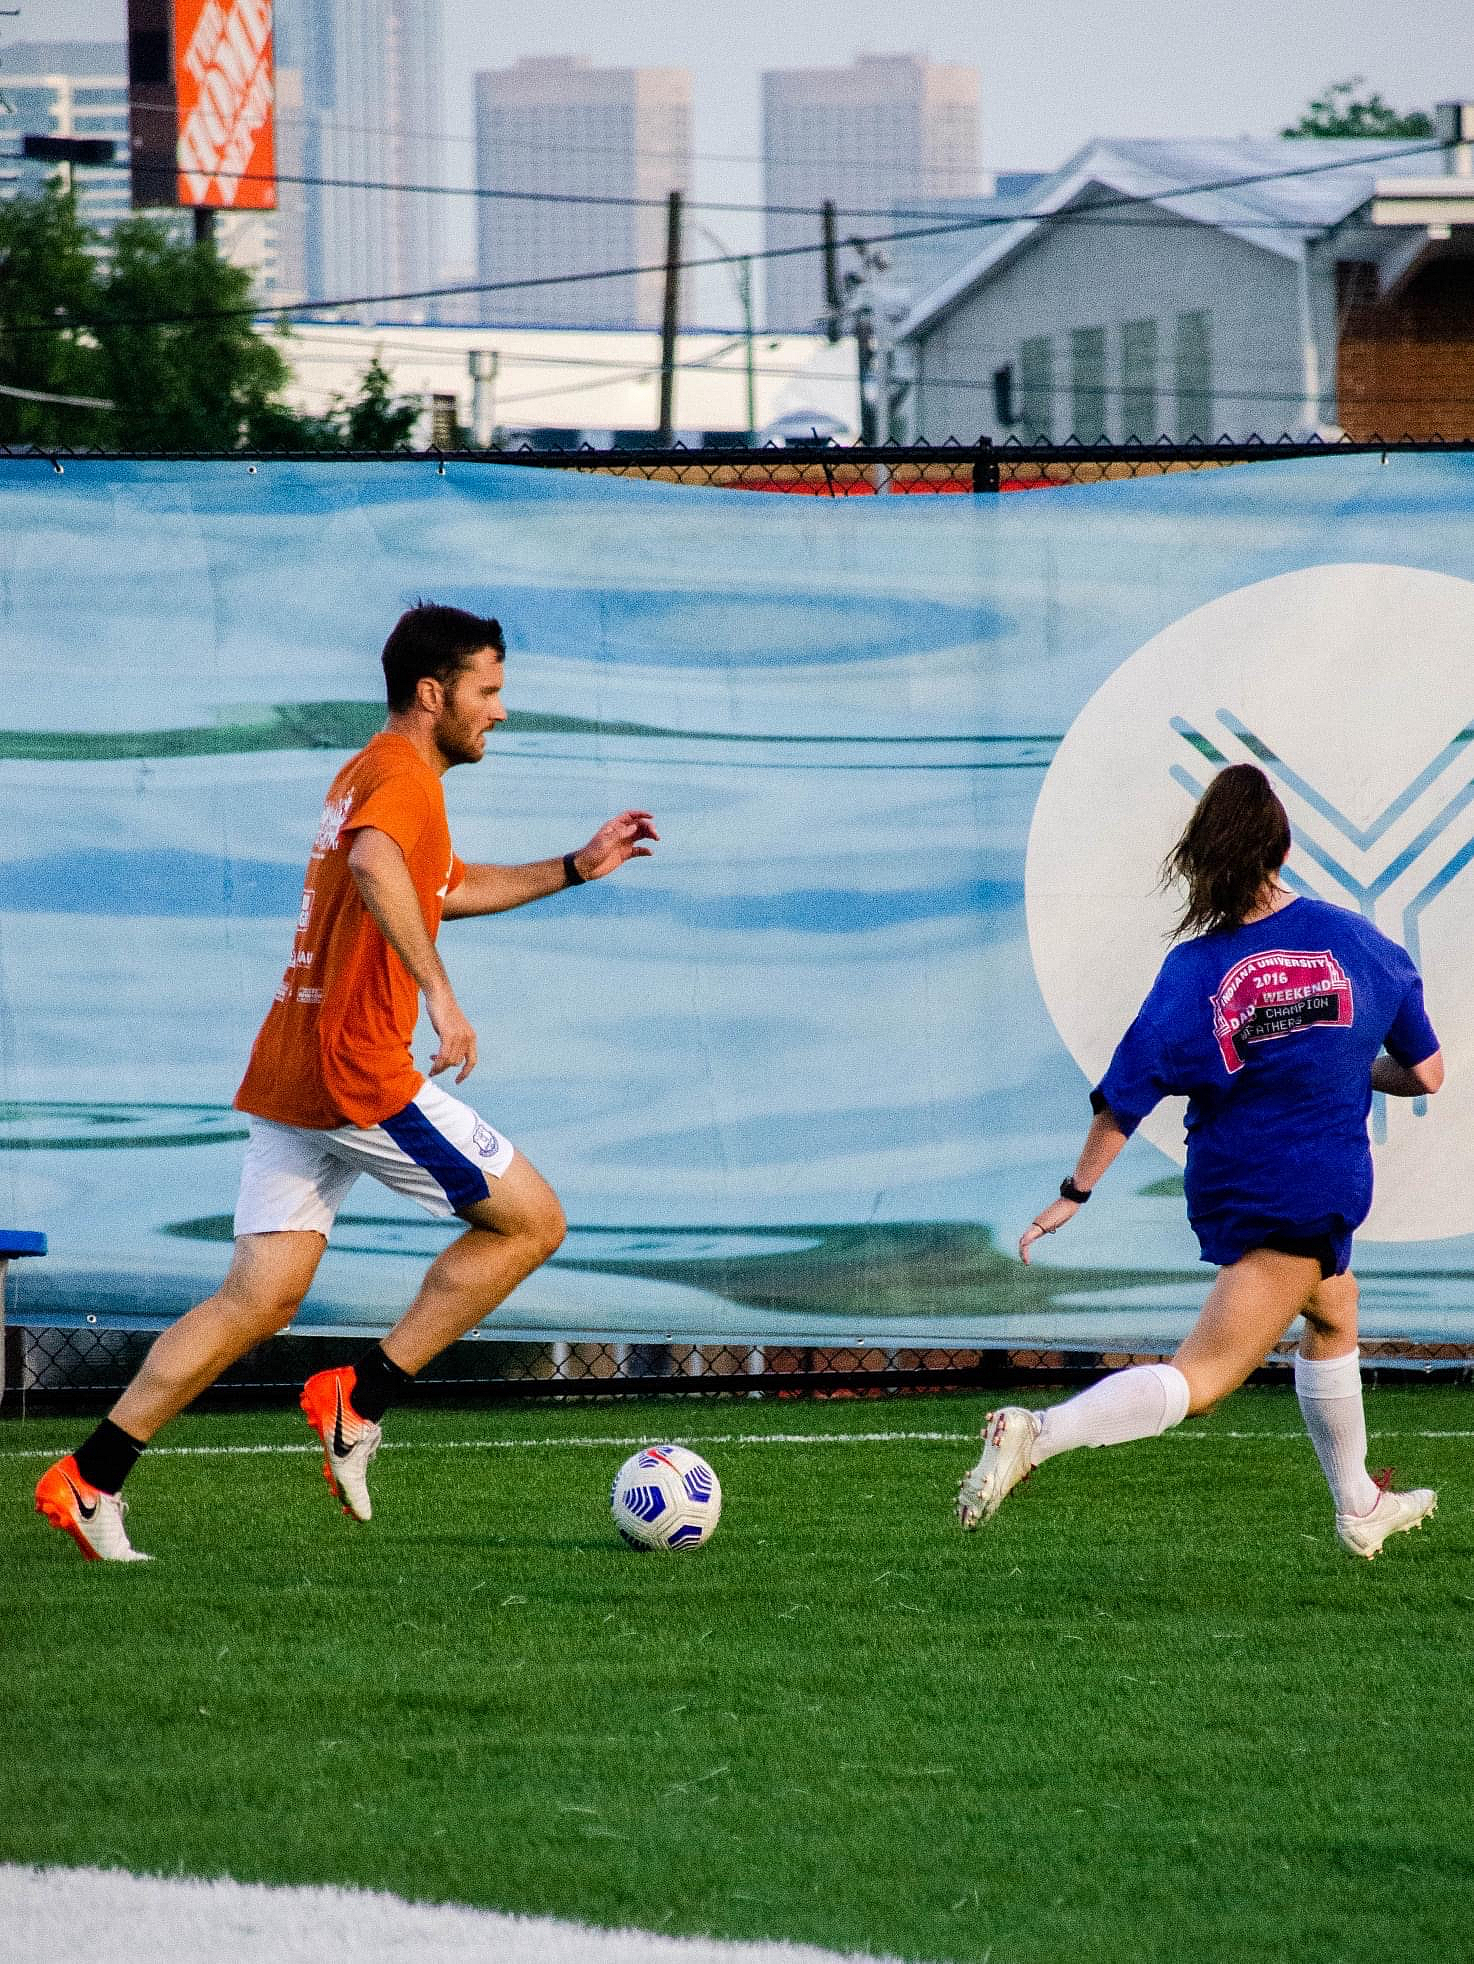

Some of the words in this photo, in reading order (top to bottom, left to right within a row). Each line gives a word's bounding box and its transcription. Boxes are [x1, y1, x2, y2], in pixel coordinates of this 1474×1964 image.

[1221, 964, 1256, 1006] INDIANA
[1257, 957, 1326, 969] UNIVERSITY
[1253, 972, 1288, 989] 2016
[1263, 979, 1331, 1003] WEEKEND
[1265, 997, 1329, 1019] CHAMPION
